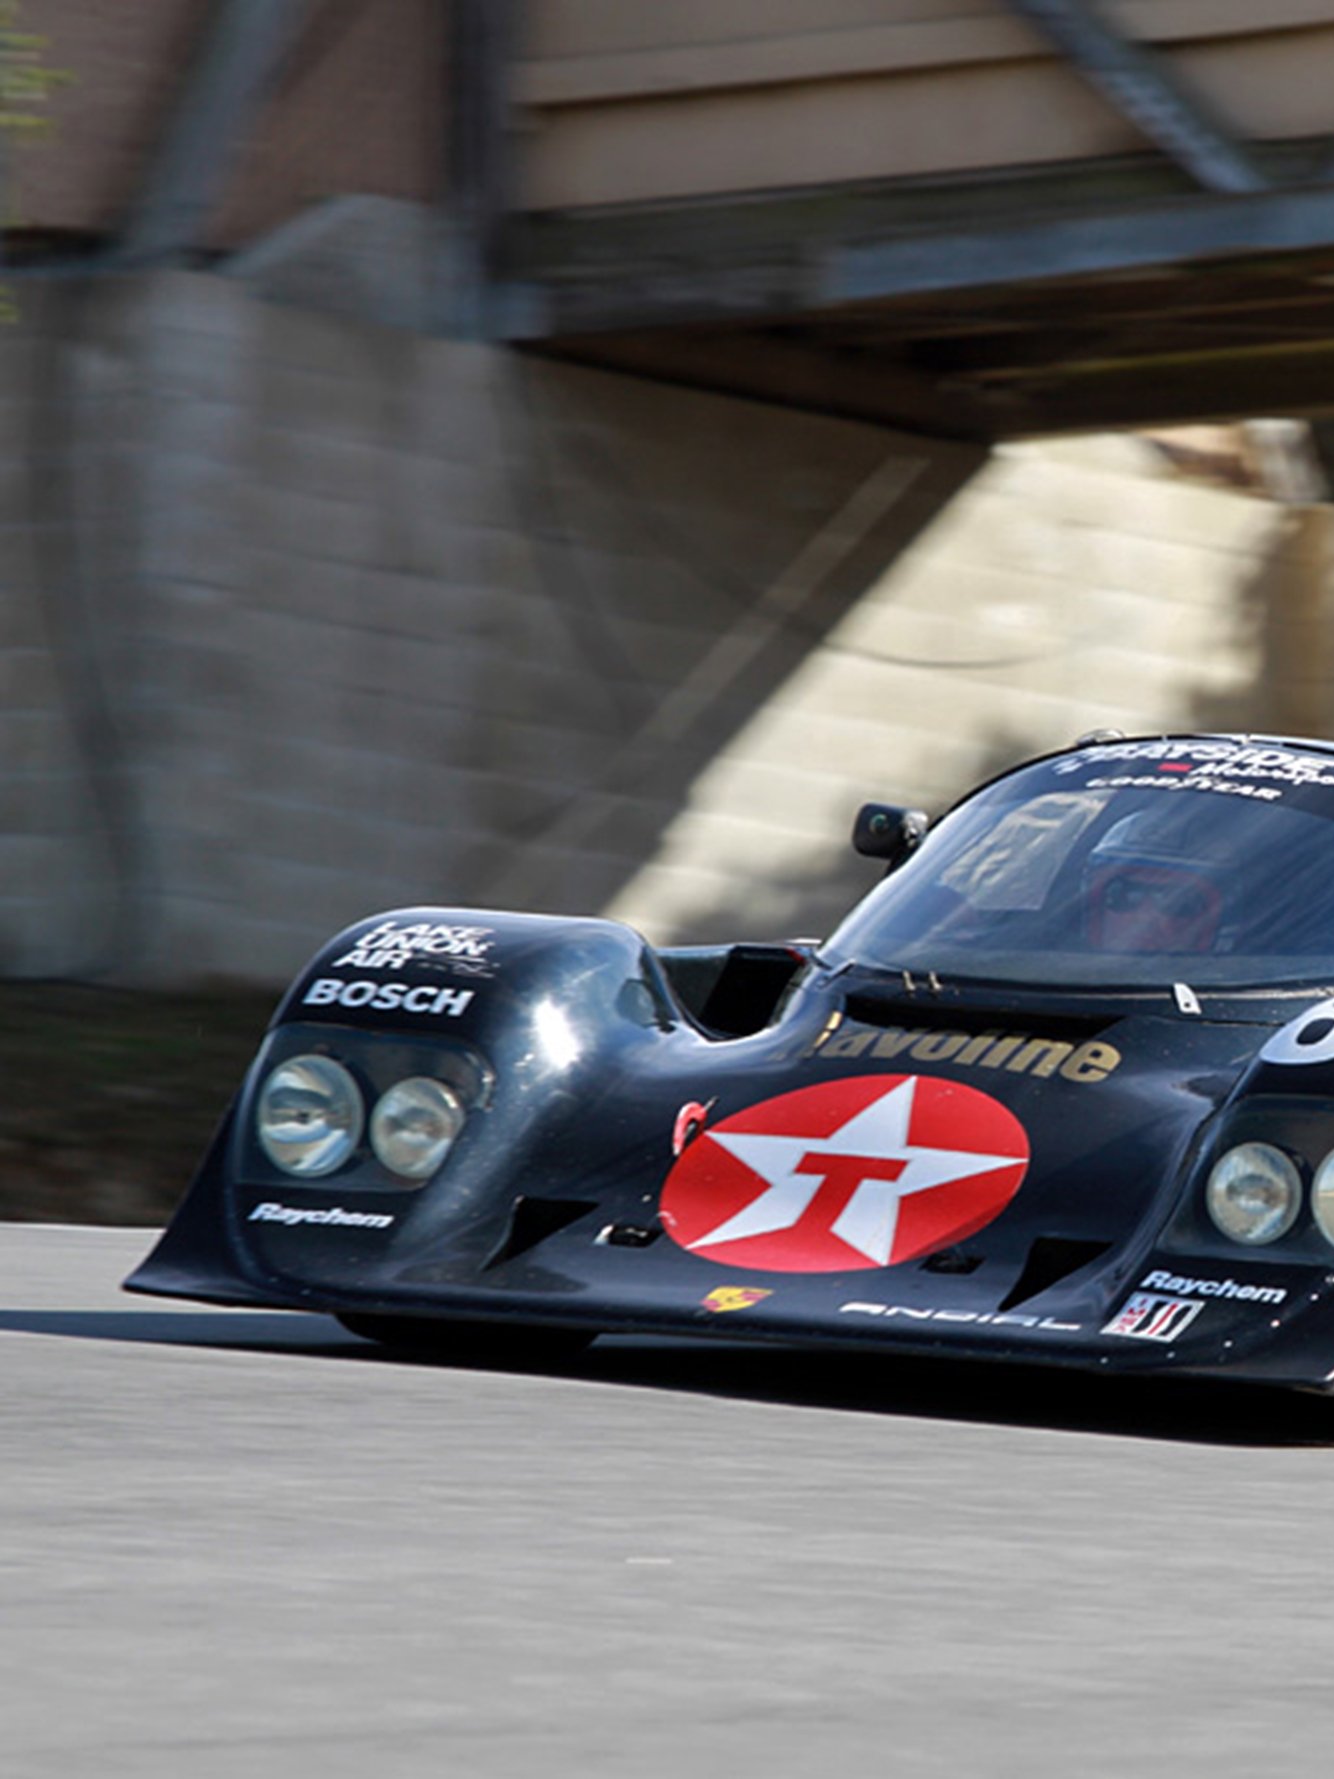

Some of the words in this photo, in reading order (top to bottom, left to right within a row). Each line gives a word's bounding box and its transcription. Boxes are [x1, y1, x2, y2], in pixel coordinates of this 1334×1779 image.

[331, 949, 412, 969] AIR
[355, 933, 494, 957] UNION
[303, 977, 474, 1017] BOSCH
[247, 1202, 395, 1229] Raychem
[1140, 1270, 1287, 1304] Raychem
[838, 1301, 1082, 1331] ANDIAL
